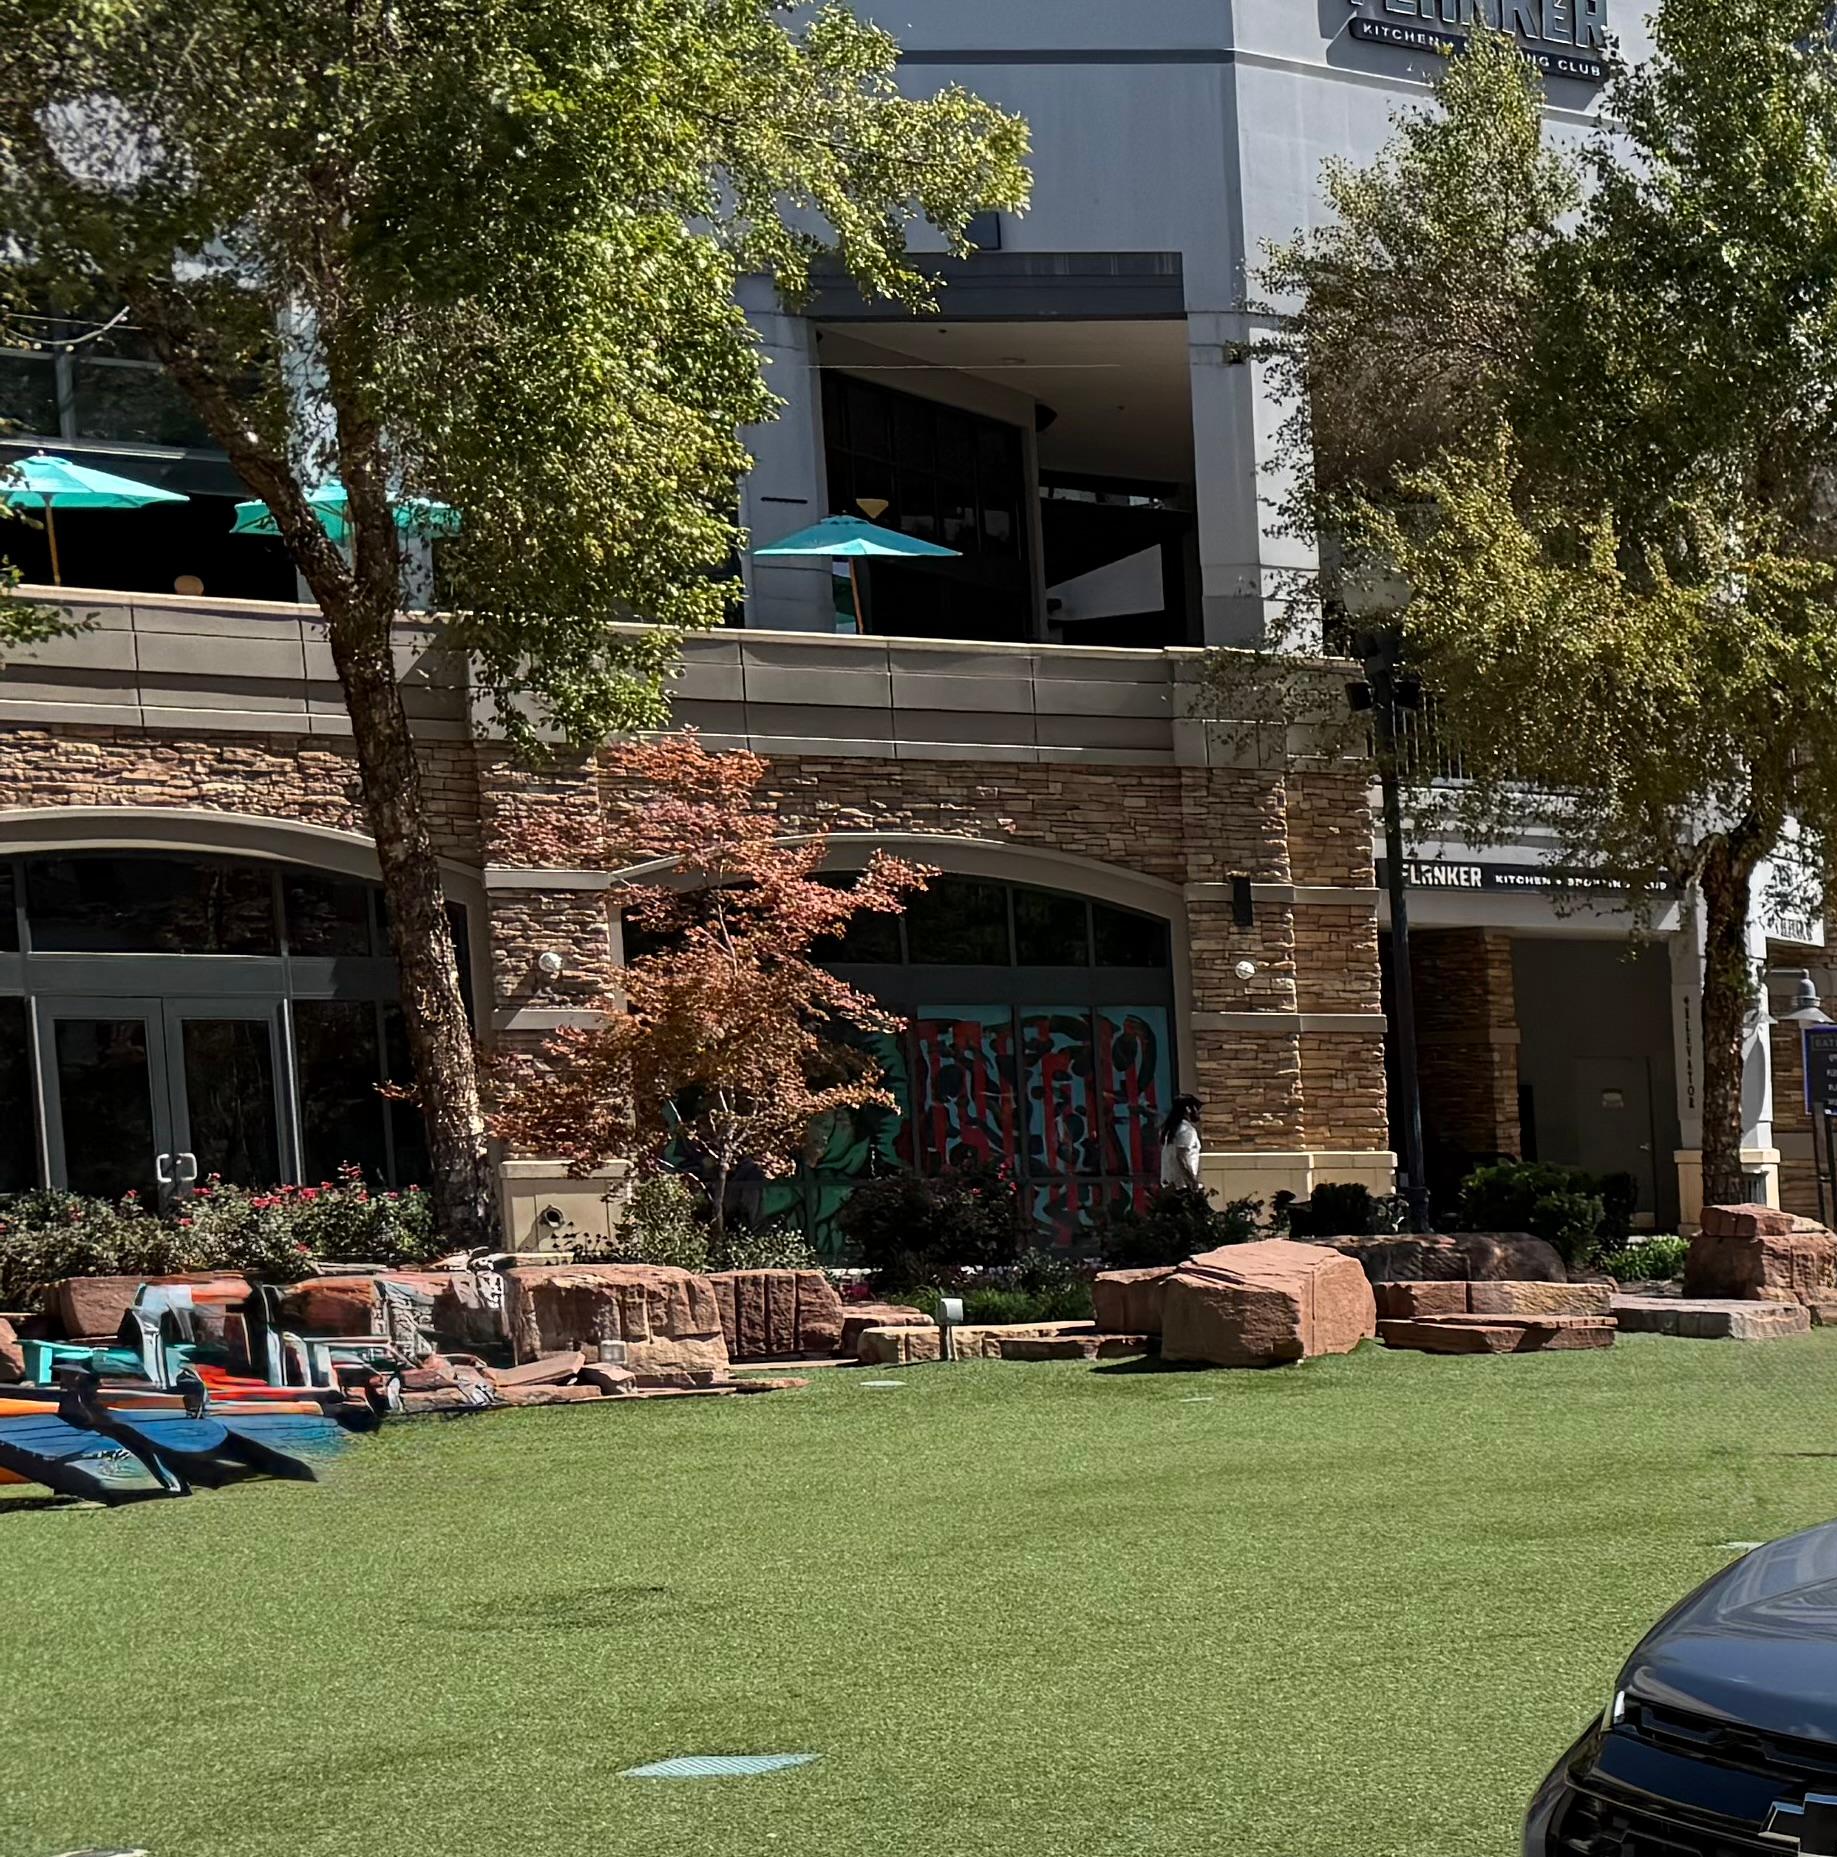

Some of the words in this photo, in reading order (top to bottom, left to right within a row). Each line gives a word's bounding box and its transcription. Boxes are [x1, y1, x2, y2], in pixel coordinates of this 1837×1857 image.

[1363, 23, 1440, 47] KITCHEN
[1558, 59, 1601, 78] CLUB
[1495, 874, 1551, 886] KITCHEN
